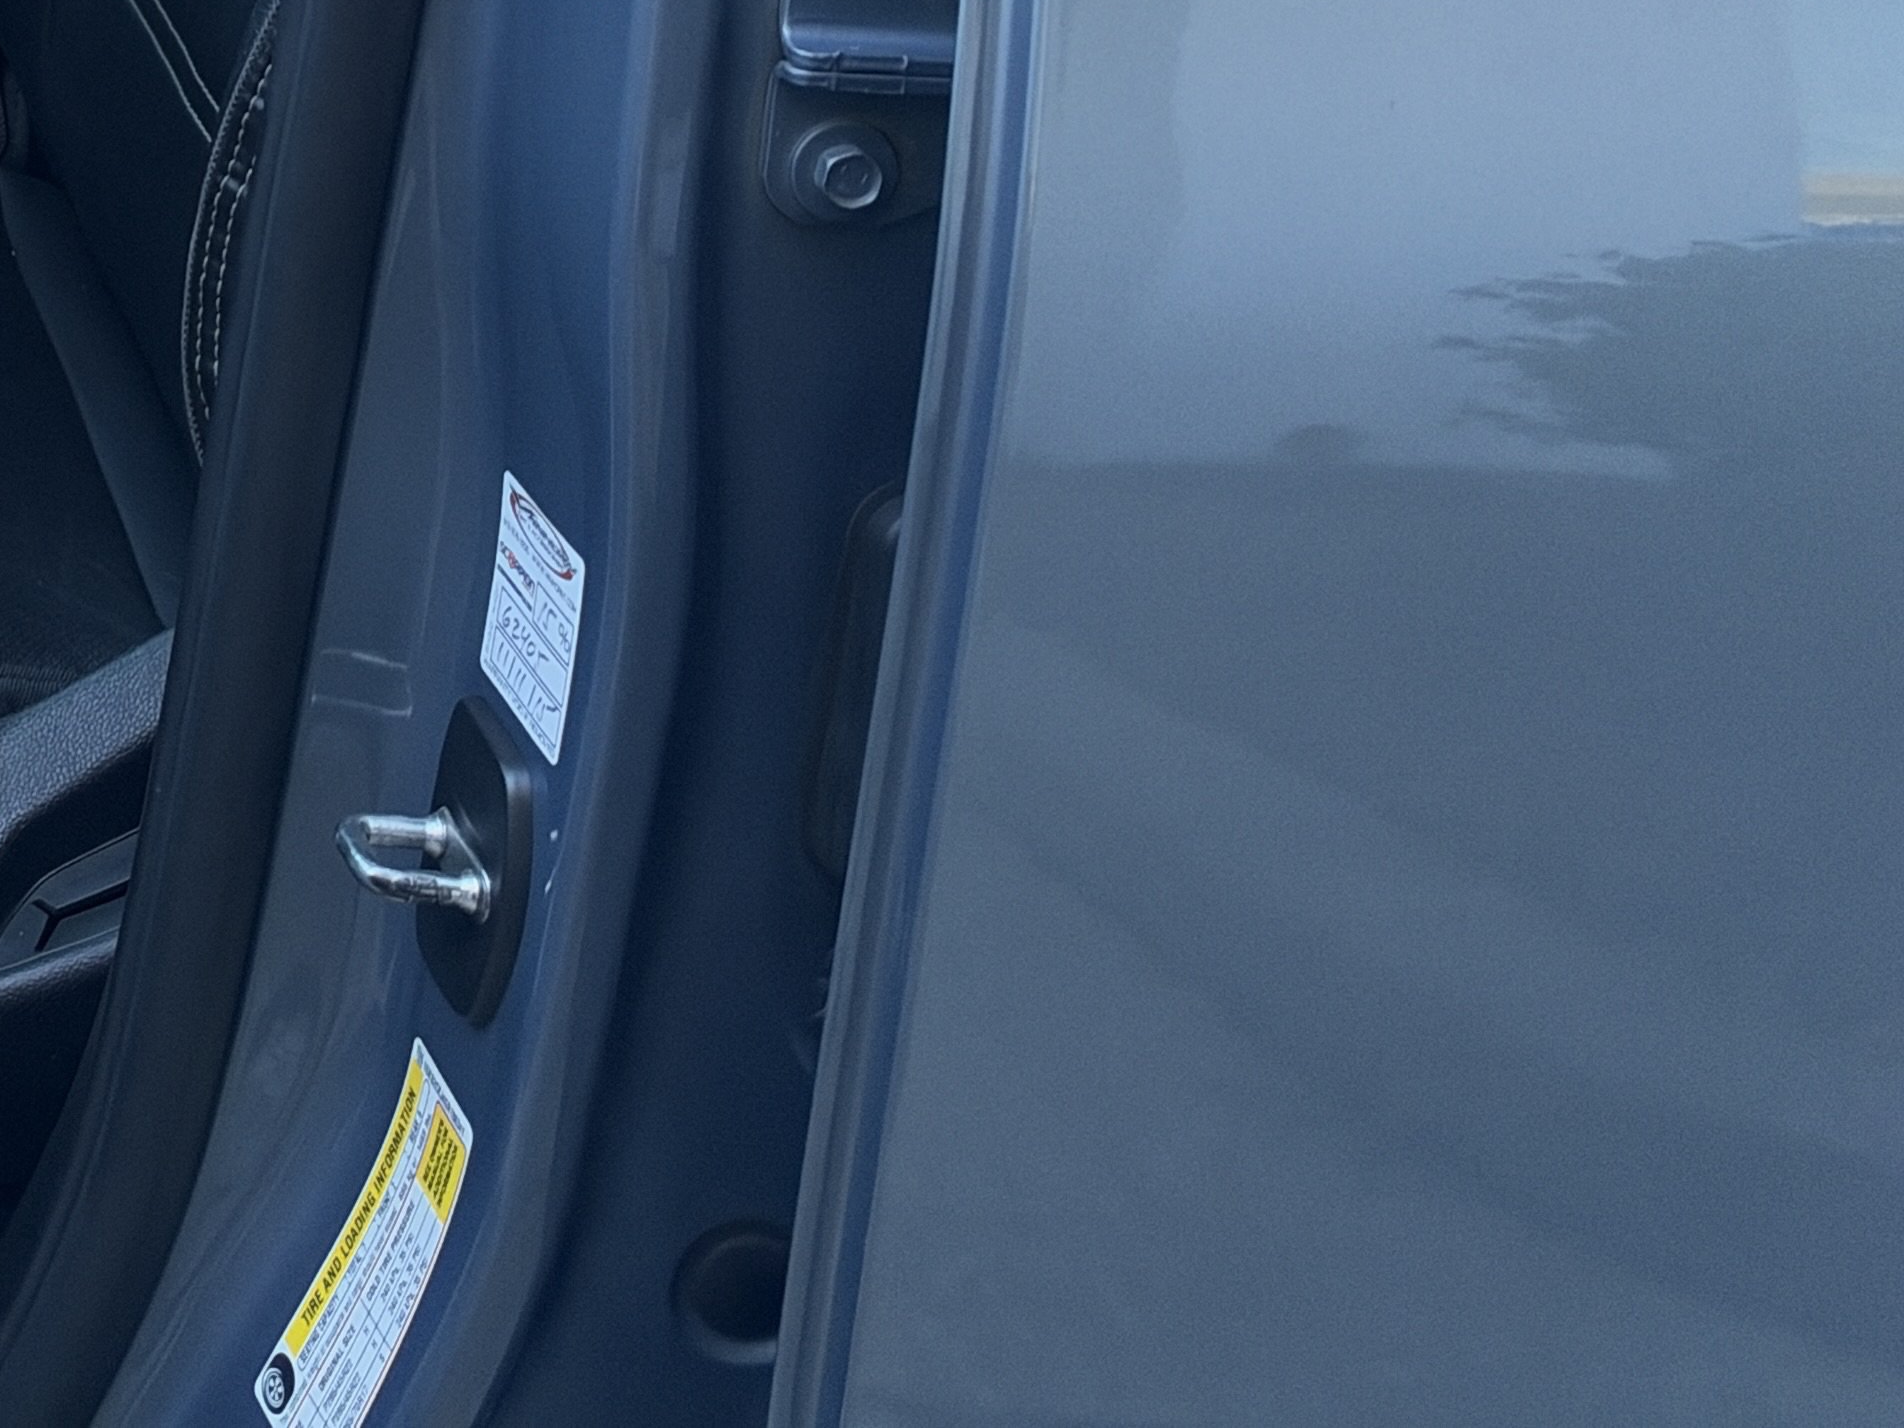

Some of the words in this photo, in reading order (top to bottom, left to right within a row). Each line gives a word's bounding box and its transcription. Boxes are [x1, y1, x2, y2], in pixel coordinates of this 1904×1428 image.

[300, 1288, 325, 1326] TIRE
[322, 1256, 343, 1293] AND
[339, 1191, 377, 1259] LOADING
[374, 1086, 418, 1193] INFORMATION
[366, 1274, 382, 1302] COLD
[379, 1251, 393, 1274] TIRE
[391, 1199, 416, 1252] PRESSURE
